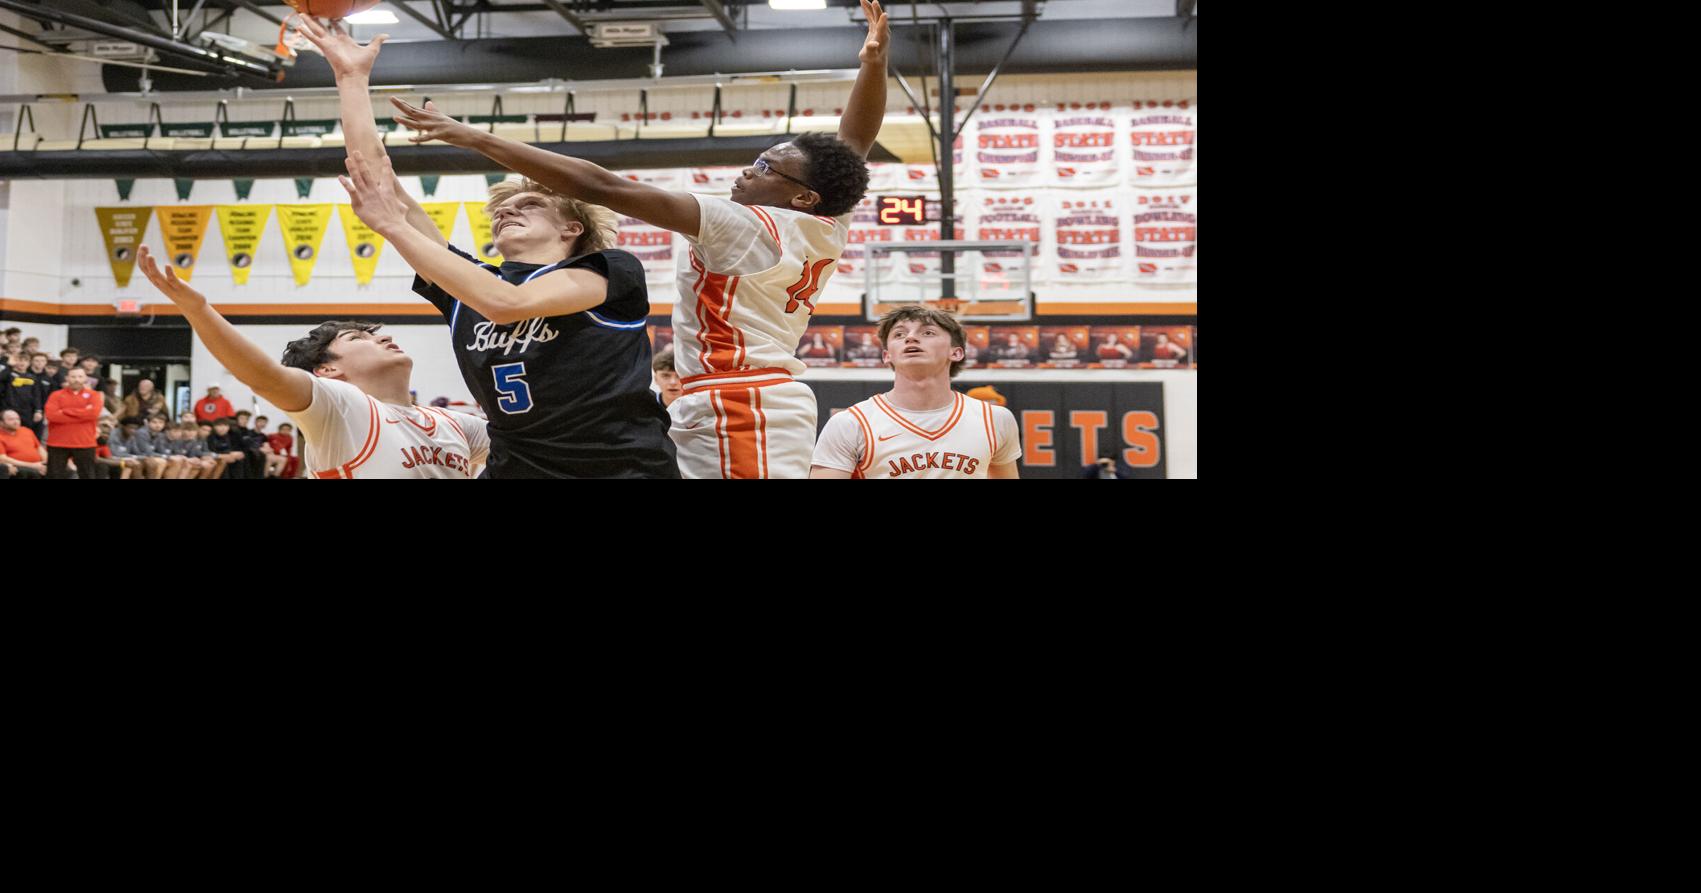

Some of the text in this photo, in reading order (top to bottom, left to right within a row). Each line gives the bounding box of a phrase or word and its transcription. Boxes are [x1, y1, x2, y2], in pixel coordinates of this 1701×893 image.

[977, 134, 1039, 149] STATE
[1053, 132, 1114, 148] STATE
[1130, 130, 1194, 146] STATE
[880, 196, 923, 224] 24
[617, 231, 672, 246] STATE
[904, 228, 965, 241] STAE
[979, 227, 1040, 242] STATE
[1056, 229, 1120, 245] STATE
[1134, 226, 1196, 242] STATE
[466, 316, 560, 356] Buffs
[491, 361, 534, 415] 5
[400, 445, 470, 477] JACKETS
[888, 451, 980, 478] JACKETS
